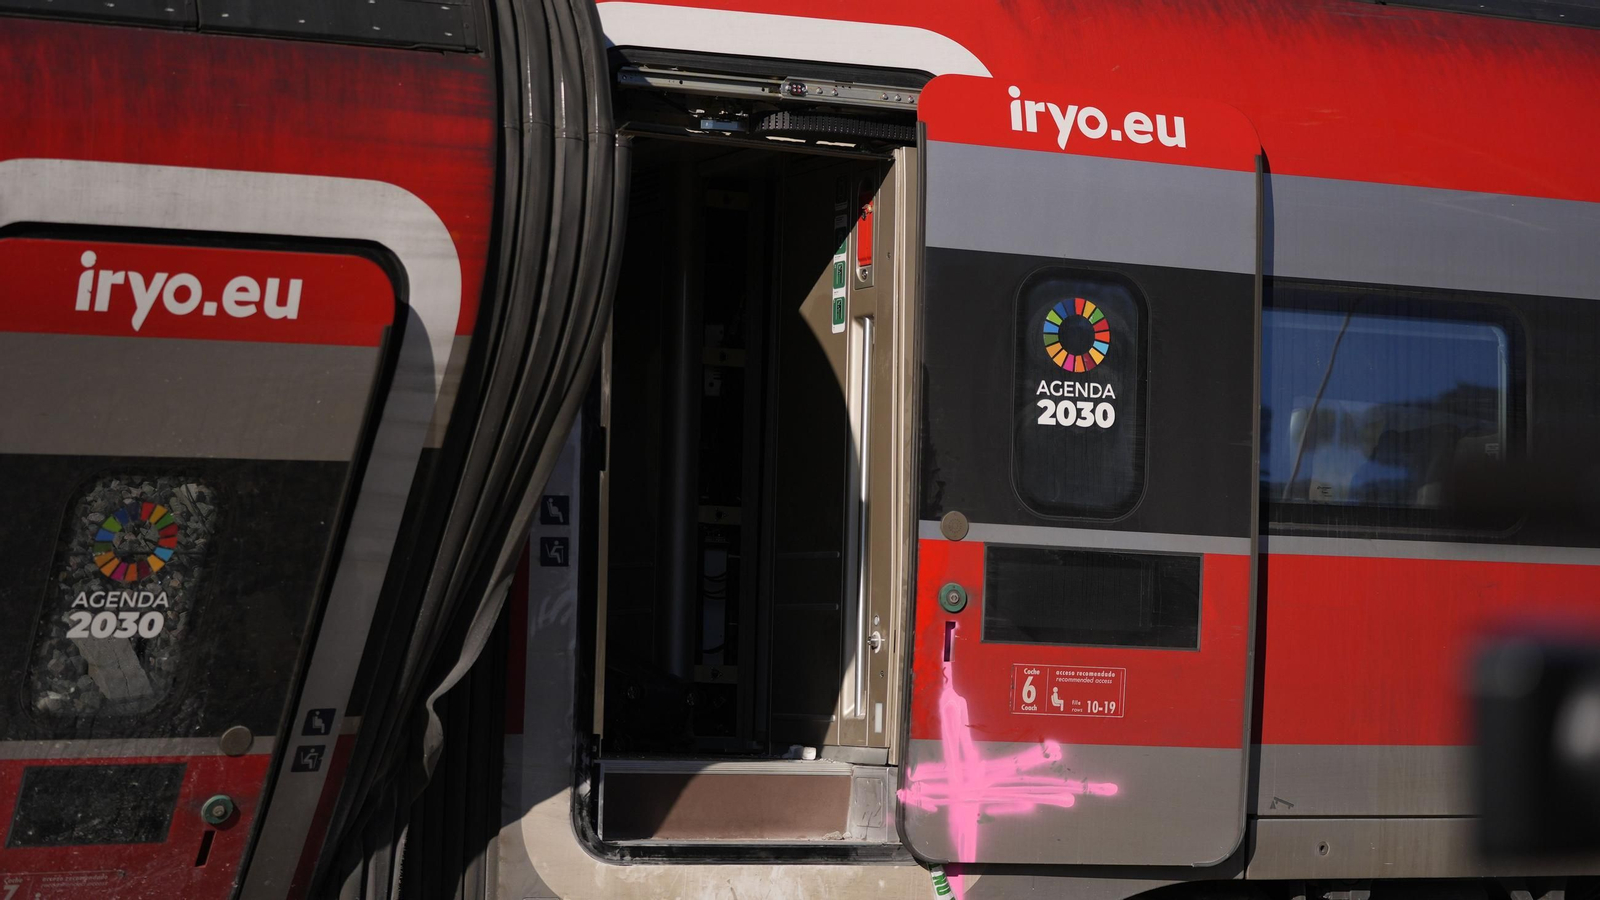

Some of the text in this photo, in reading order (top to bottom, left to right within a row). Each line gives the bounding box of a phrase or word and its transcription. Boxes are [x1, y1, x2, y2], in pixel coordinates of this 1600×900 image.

[1007, 85, 1187, 150] iryo.eu
[75, 250, 303, 332] iryo.eu
[1036, 380, 1116, 399] AGENDA
[1036, 399, 1116, 429] 2030
[71, 591, 170, 608] AGENDA
[66, 611, 165, 639] 2030
[1076, 670, 1116, 678] recomendado
[1022, 676, 1037, 704] 6
[1086, 700, 1116, 714] 10-19
[3, 884, 20, 900] 7
